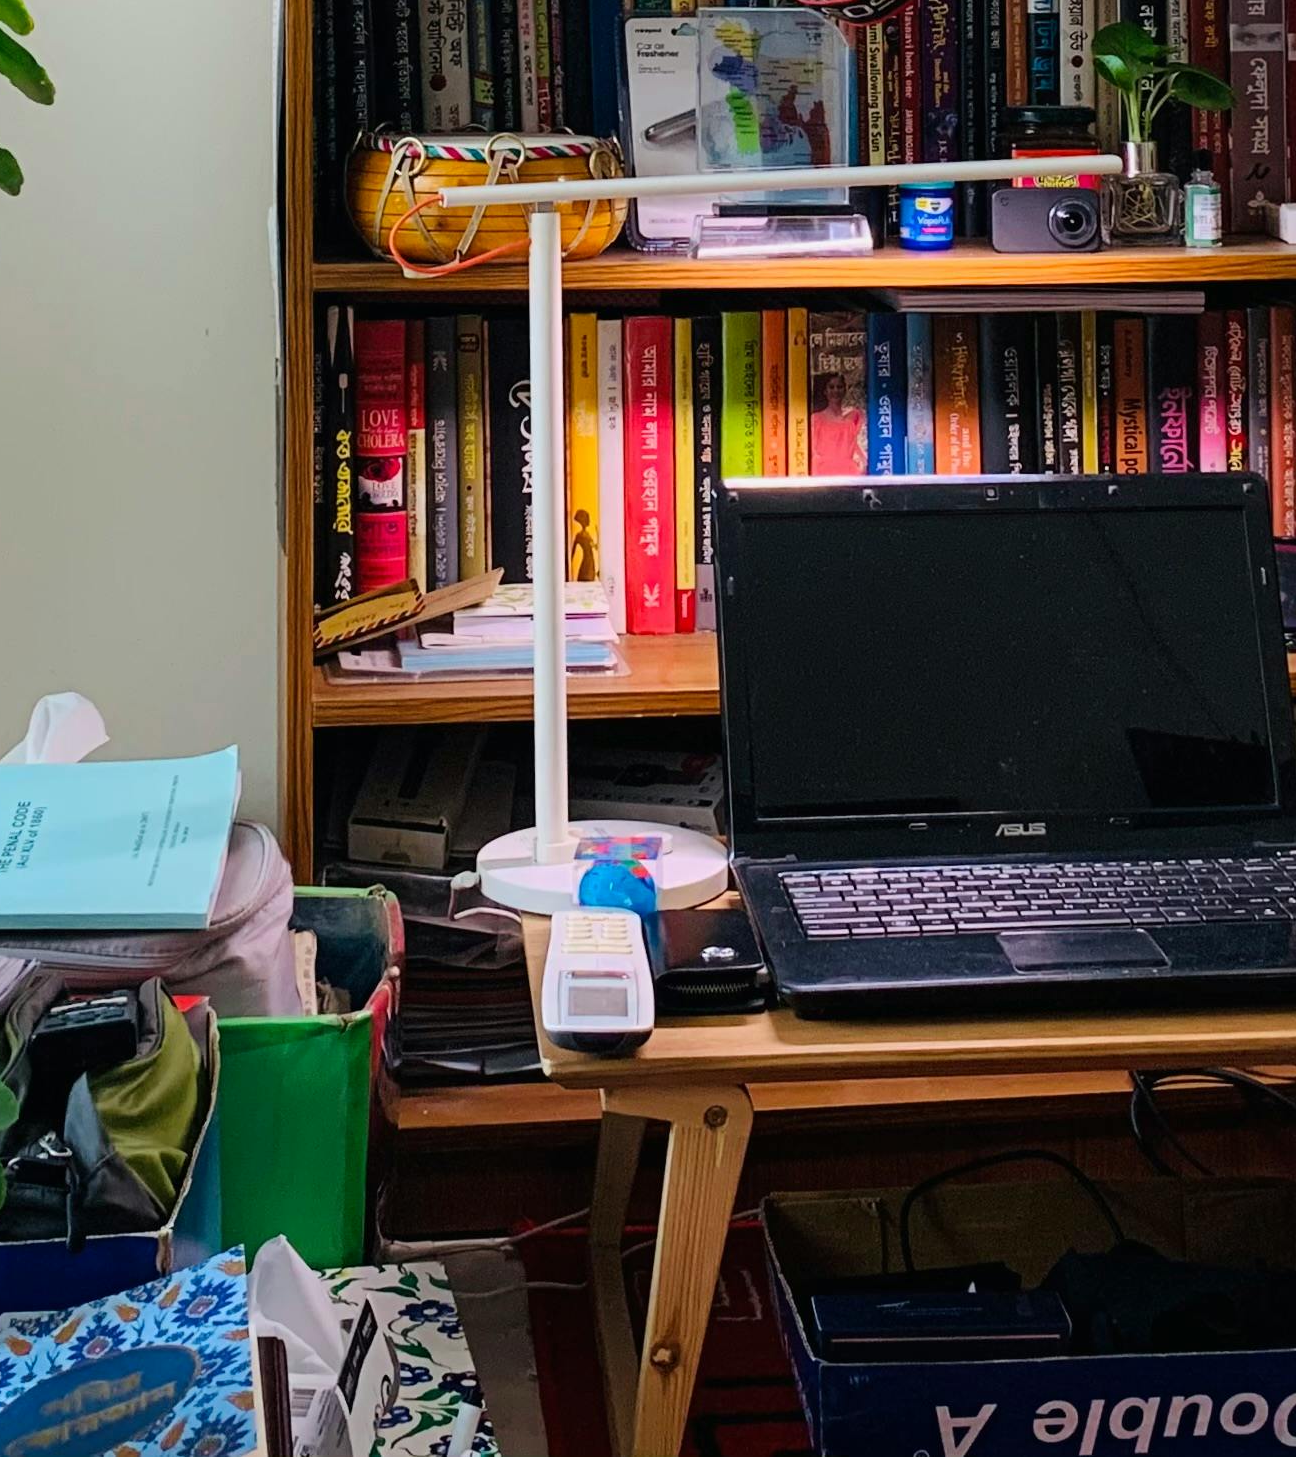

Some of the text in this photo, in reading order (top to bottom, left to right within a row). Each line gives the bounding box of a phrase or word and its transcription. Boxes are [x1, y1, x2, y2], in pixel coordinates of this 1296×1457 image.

[449, 38, 463, 68] অফ
[536, 12, 549, 70] Coelho
[1069, 30, 1089, 52] উড
[905, 51, 916, 77] book
[353, 59, 368, 131] শাহাদুজ্জামা
[537, 83, 550, 119] The
[867, 24, 882, 152] umi Swallowing the Sun
[904, 79, 913, 99] one
[1246, 56, 1269, 111] ফেলুদা
[1250, 116, 1271, 155] সমগ্র
[1245, 163, 1272, 181] ২
[954, 331, 965, 344] 5
[874, 341, 893, 437] তুষার ওরহান
[1004, 347, 1021, 406] ওয়ারলক
[1061, 385, 1077, 417] থেকে
[361, 409, 401, 432] LOVE
[1118, 398, 1143, 475] Mystical po
[1157, 385, 1194, 473] ইনফার্নো
[356, 432, 405, 448] CHOLERA
[639, 344, 660, 557] আমার নাম লাল ওরহান পামুক
[962, 428, 972, 467] and the
[1, 829, 23, 858] PENAL
[12, 800, 31, 828] CODE
[29, 830, 39, 839] of
[30, 806, 47, 829] 1860)
[995, 823, 1046, 837] ASUS
[935, 1403, 997, 1457] A
